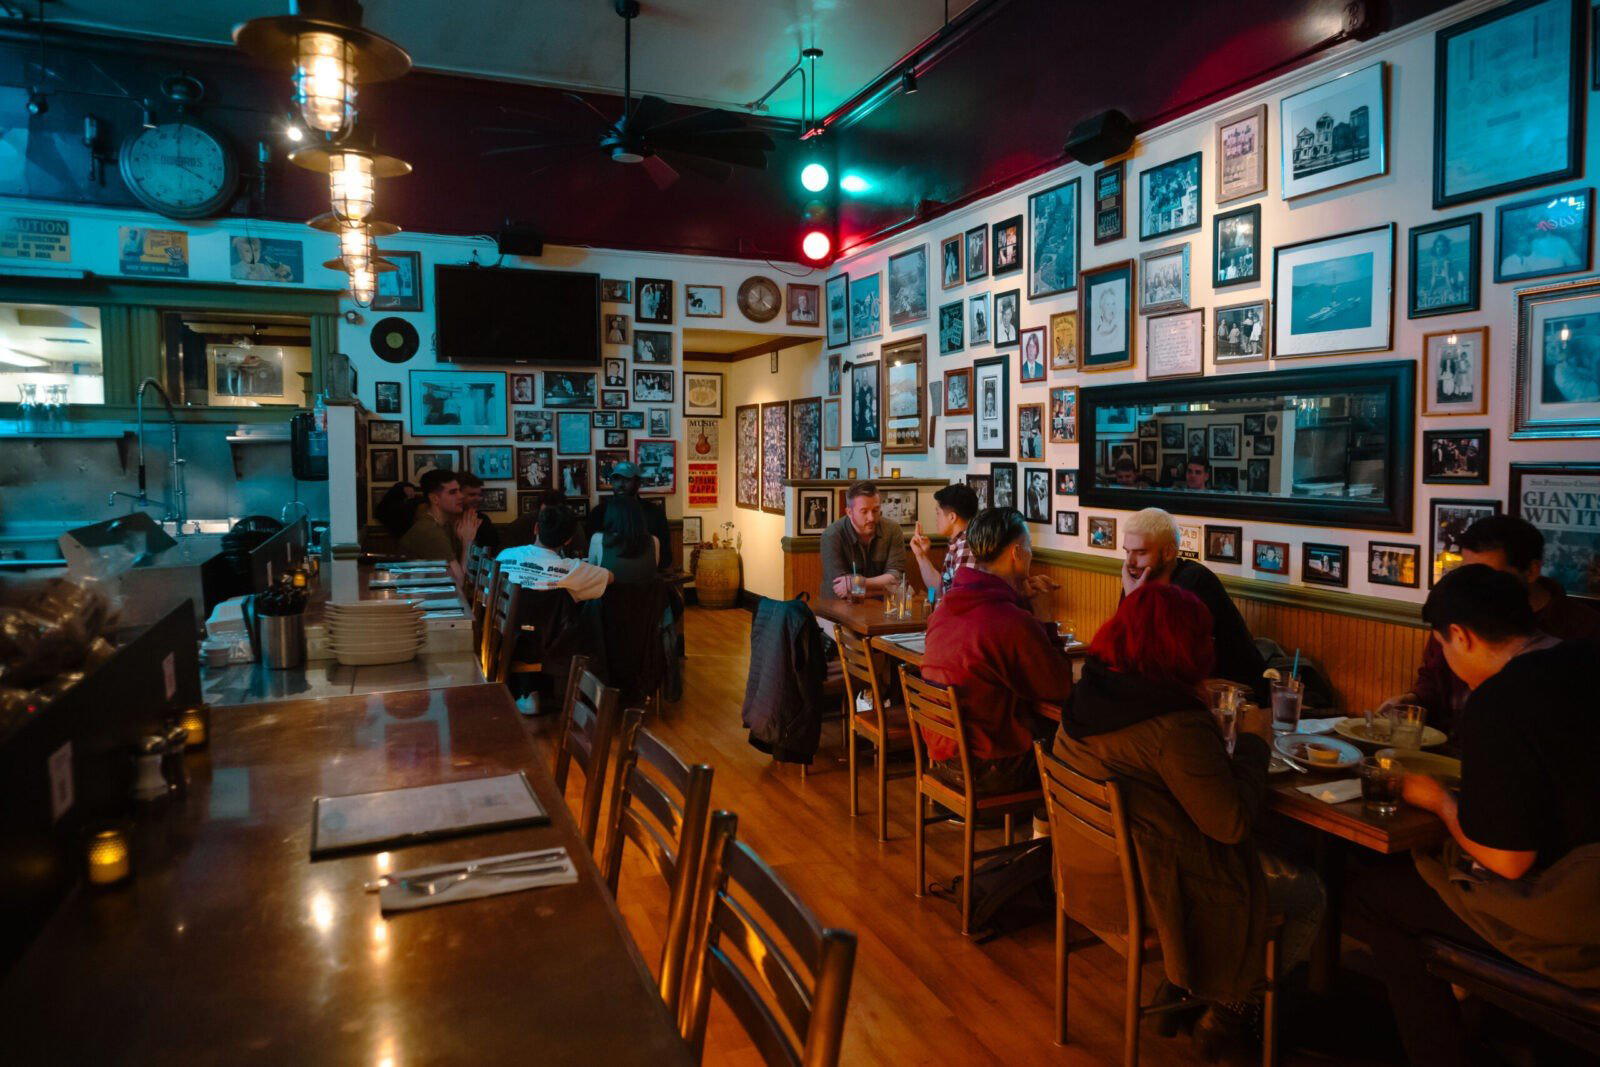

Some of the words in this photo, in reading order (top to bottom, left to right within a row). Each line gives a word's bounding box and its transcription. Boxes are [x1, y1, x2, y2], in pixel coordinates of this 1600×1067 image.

[10, 218, 67, 234] AUTION
[1524, 507, 1571, 524] WIN
[1576, 509, 1600, 526] IT
